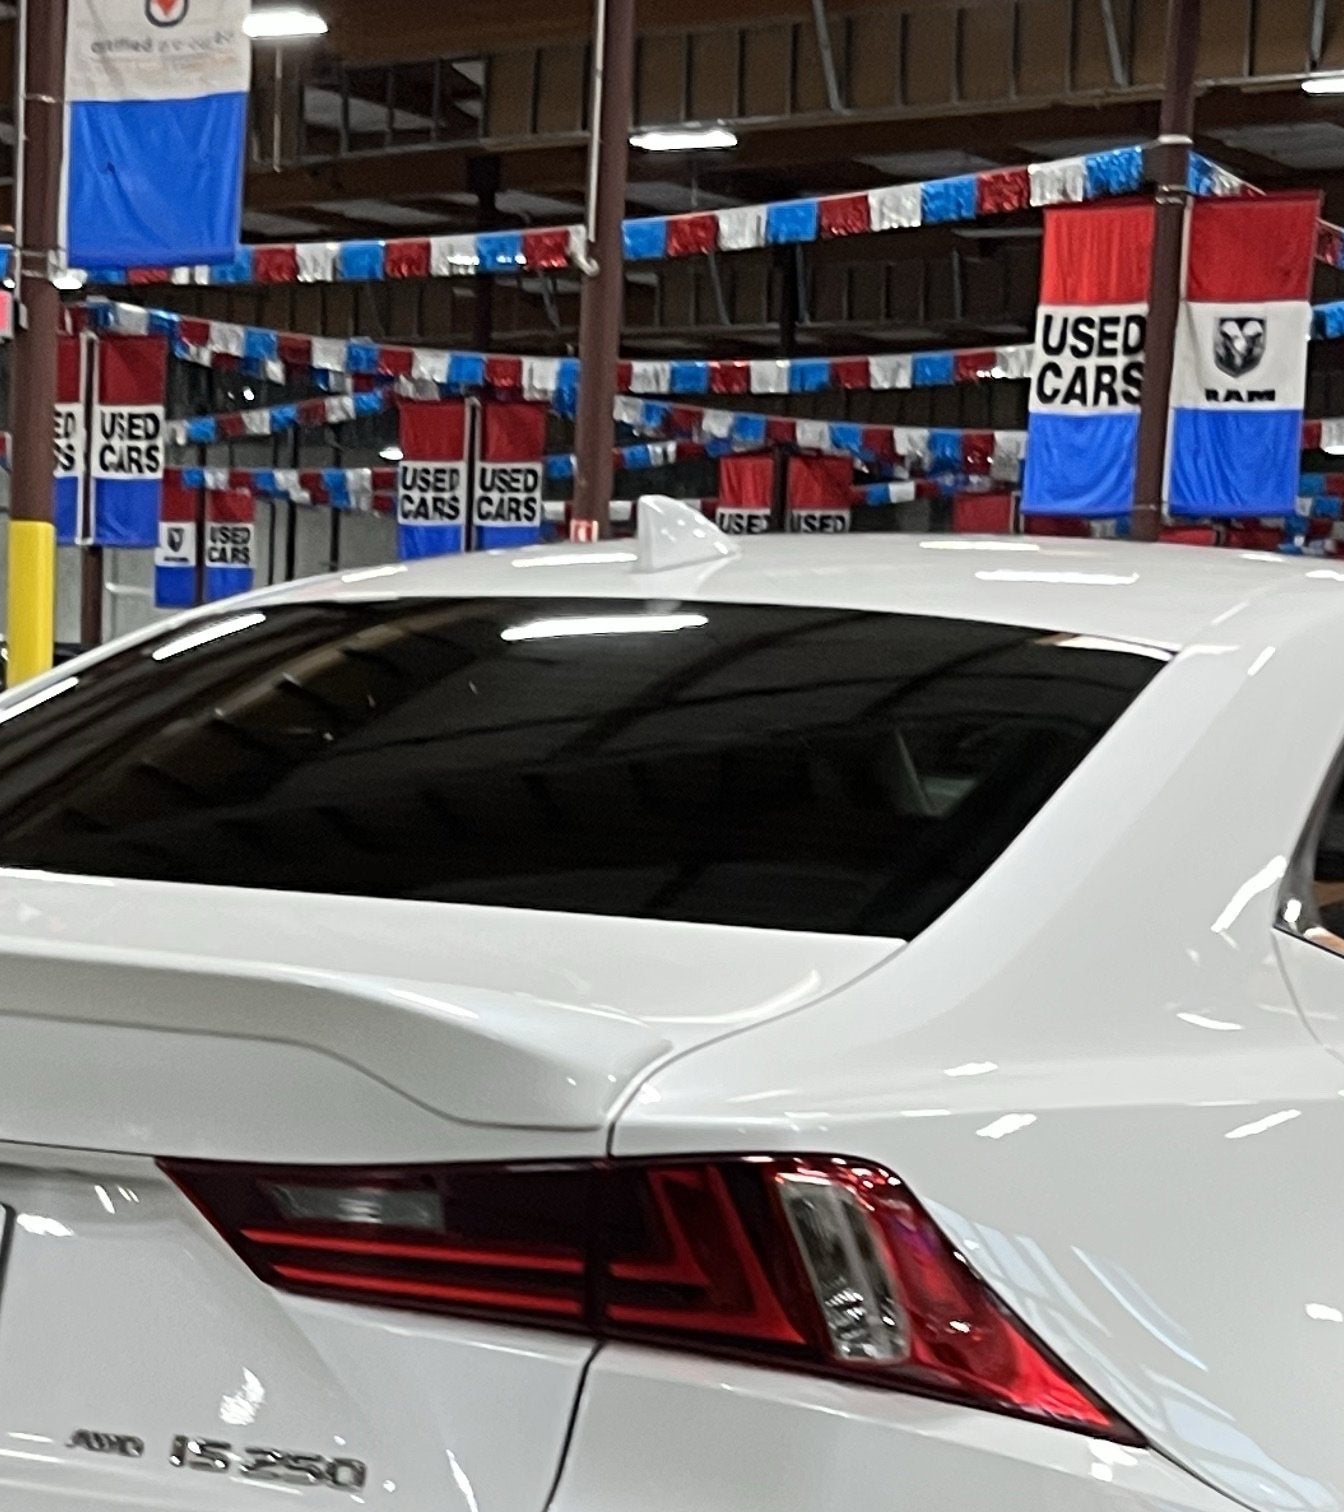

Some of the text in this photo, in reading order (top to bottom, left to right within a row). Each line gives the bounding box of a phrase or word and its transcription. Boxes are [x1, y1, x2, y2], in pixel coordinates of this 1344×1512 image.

[1042, 314, 1147, 358] USED
[1037, 361, 1144, 406] CARS
[100, 412, 161, 440] USED
[99, 445, 160, 473] CARS
[401, 466, 460, 492] USED
[479, 467, 538, 493] USED
[401, 494, 460, 520] CARS
[477, 496, 537, 521] CARS
